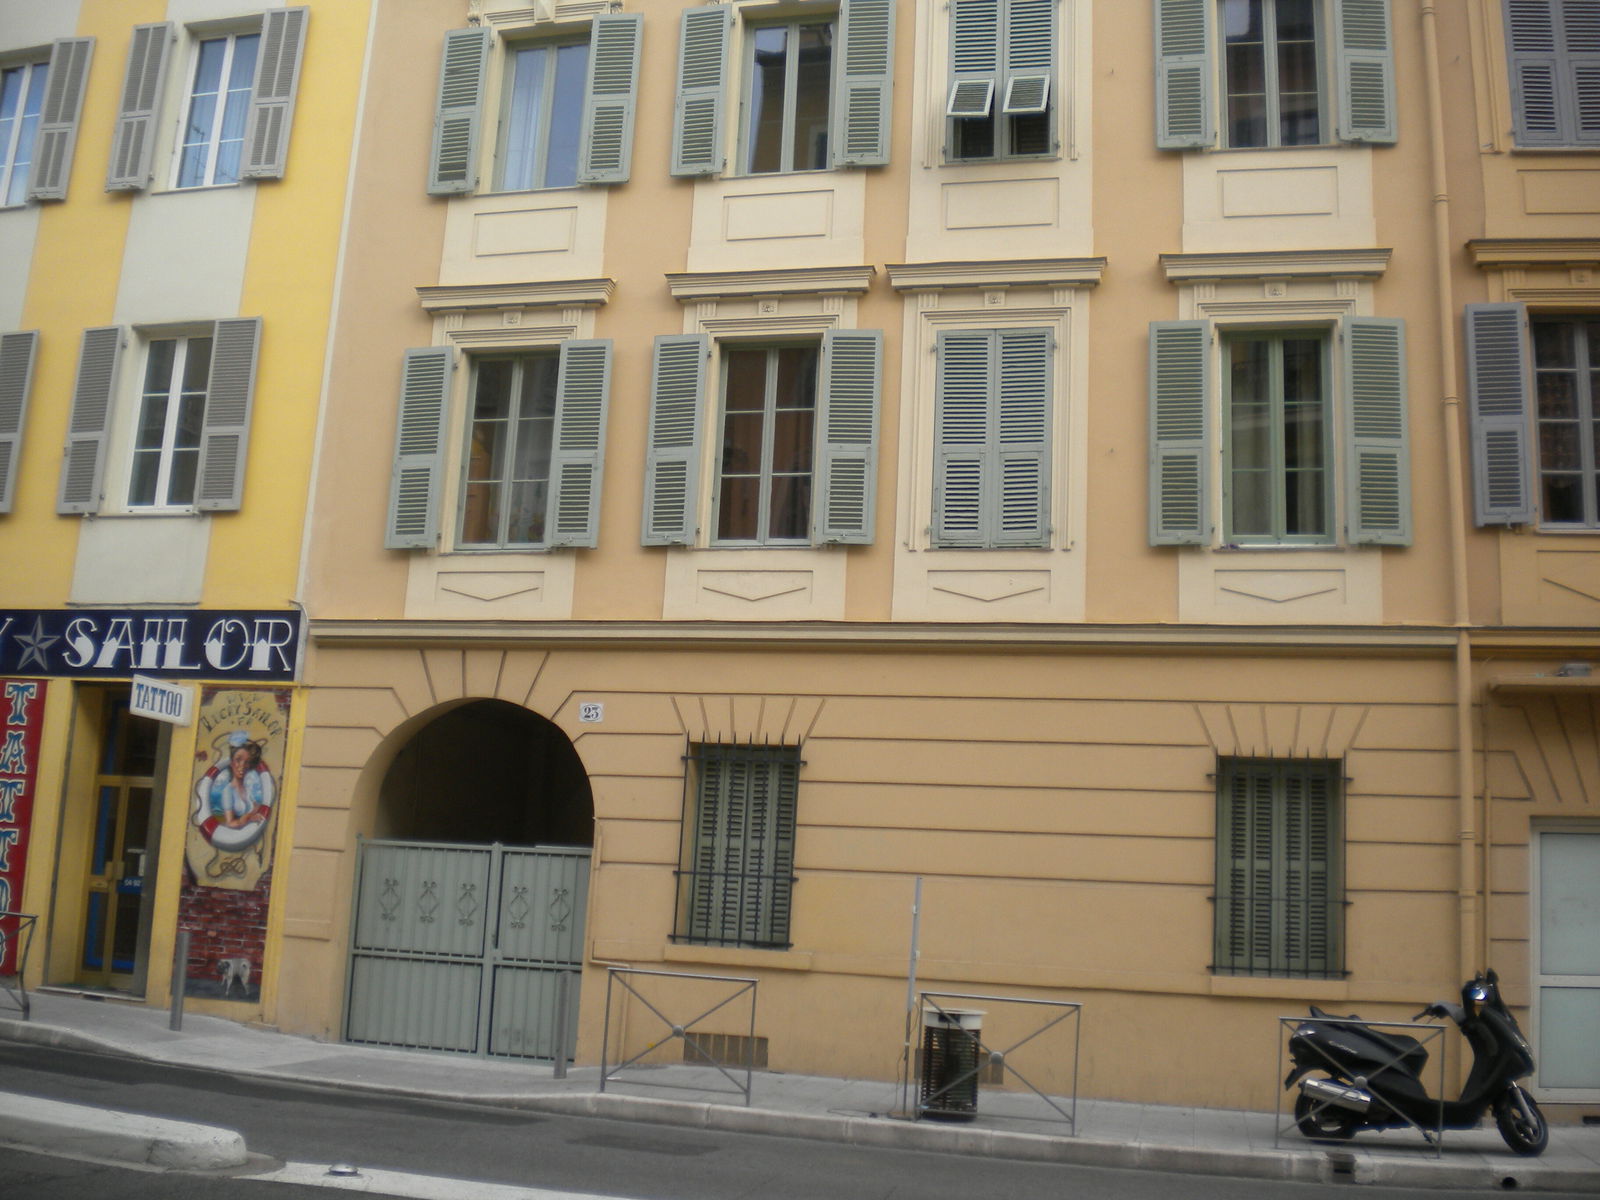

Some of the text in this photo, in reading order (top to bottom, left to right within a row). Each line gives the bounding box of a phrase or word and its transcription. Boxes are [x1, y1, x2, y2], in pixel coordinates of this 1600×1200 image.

[62, 617, 292, 671] SAILOR
[135, 683, 182, 717] TATTOO
[0, 682, 37, 966] TATT
